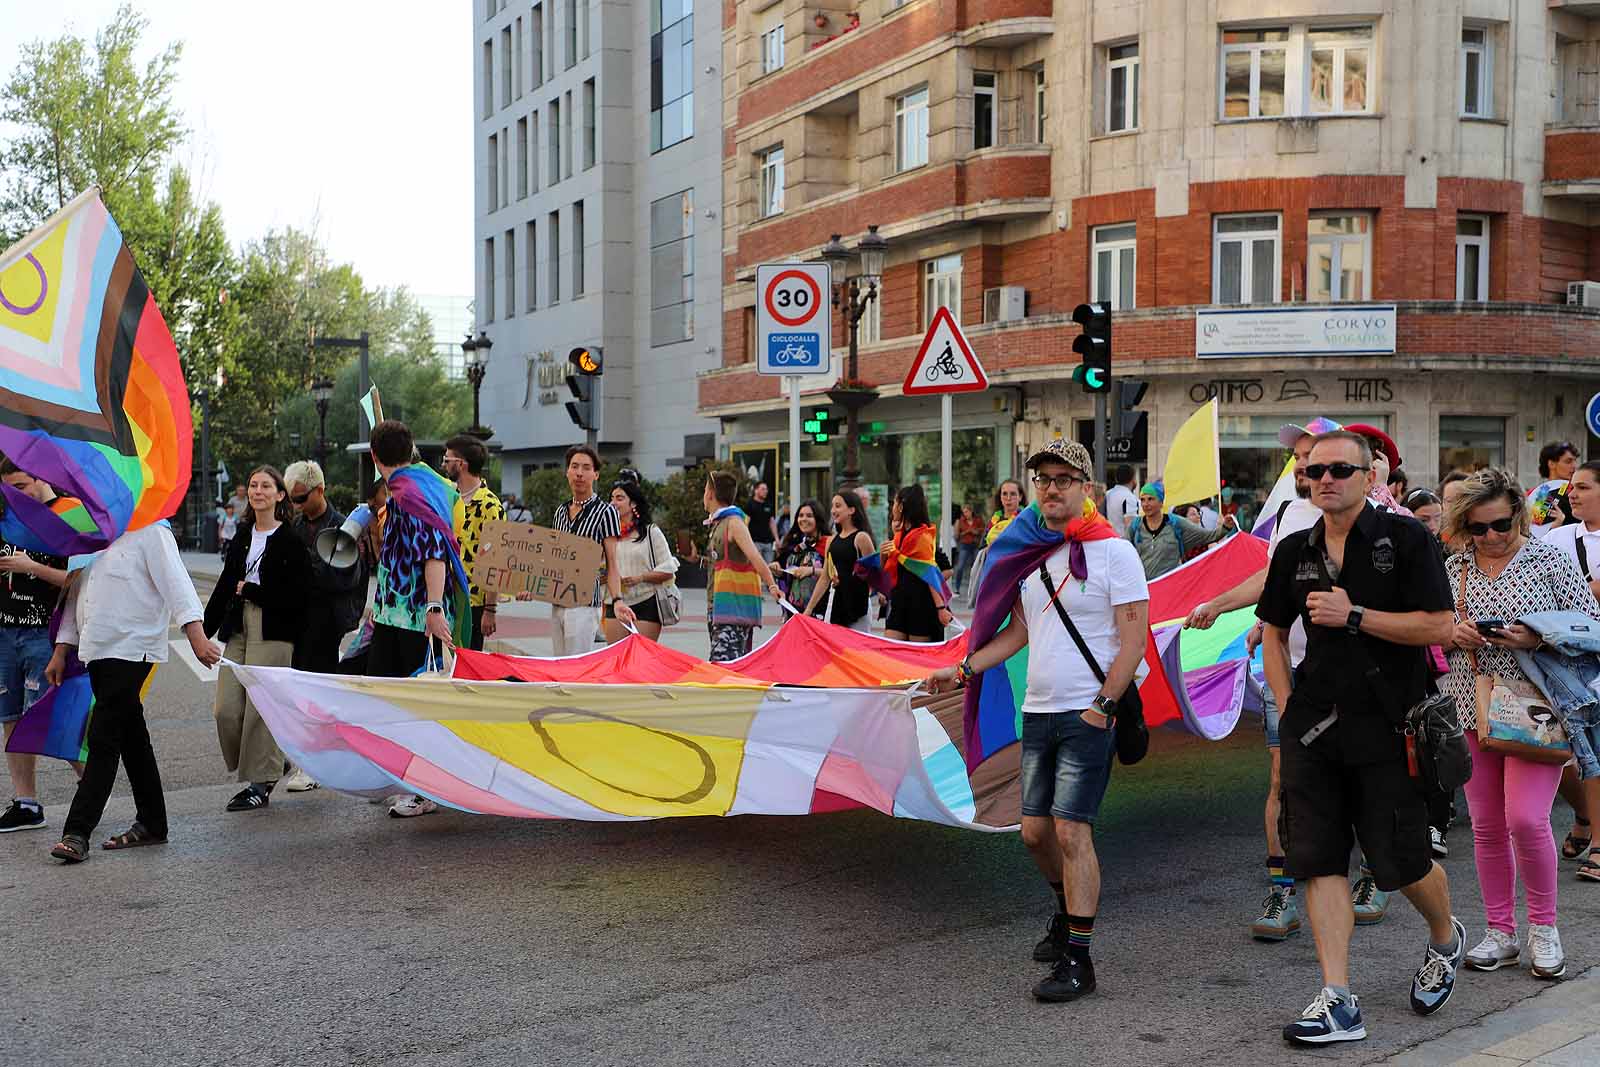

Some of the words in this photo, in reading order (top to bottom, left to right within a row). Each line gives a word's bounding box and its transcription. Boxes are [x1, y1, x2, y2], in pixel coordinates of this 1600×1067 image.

[777, 289, 809, 307] 30
[1324, 318, 1387, 329] CORVO
[771, 335, 816, 343] CICLOCALLE
[1337, 378, 1393, 403] HATS
[500, 532, 543, 553] Somos
